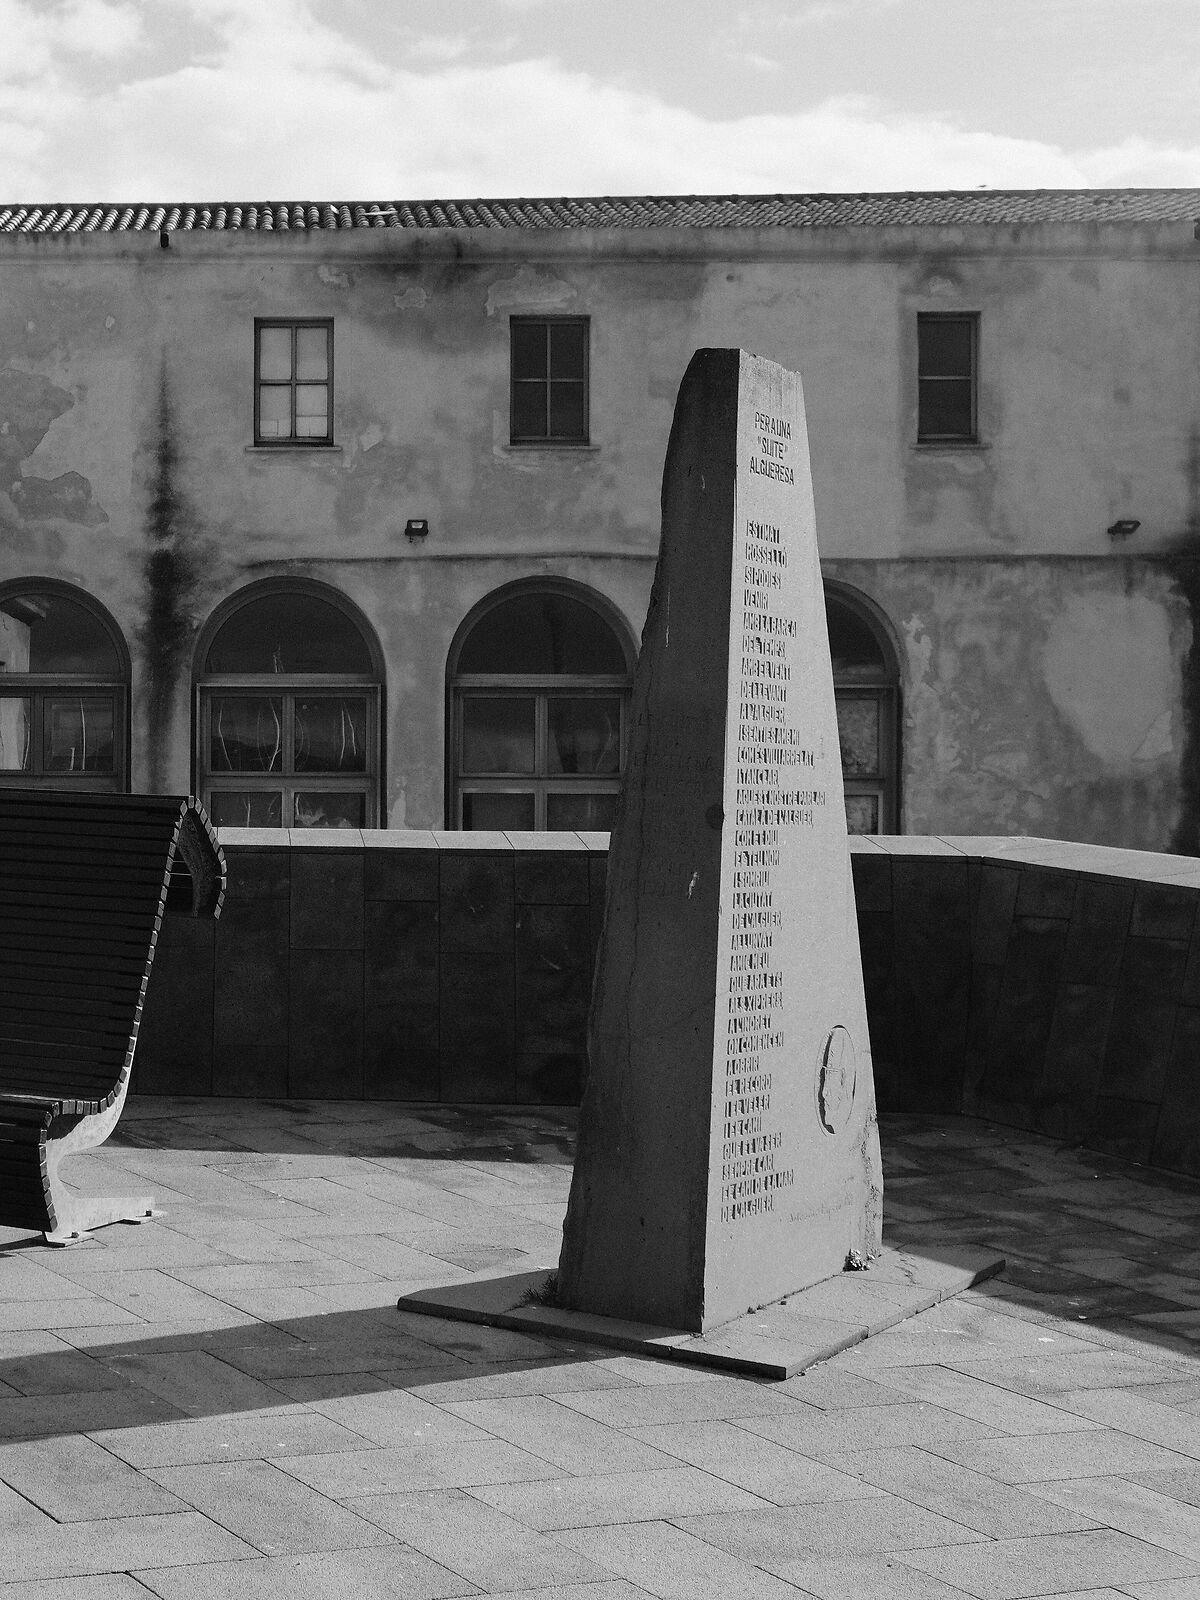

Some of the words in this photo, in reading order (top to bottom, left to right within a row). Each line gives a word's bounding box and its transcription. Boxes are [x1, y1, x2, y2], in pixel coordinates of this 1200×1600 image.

[754, 412, 771, 433] PER
[777, 418, 792, 439] UNA
[750, 457, 795, 485] ALGUERESA
